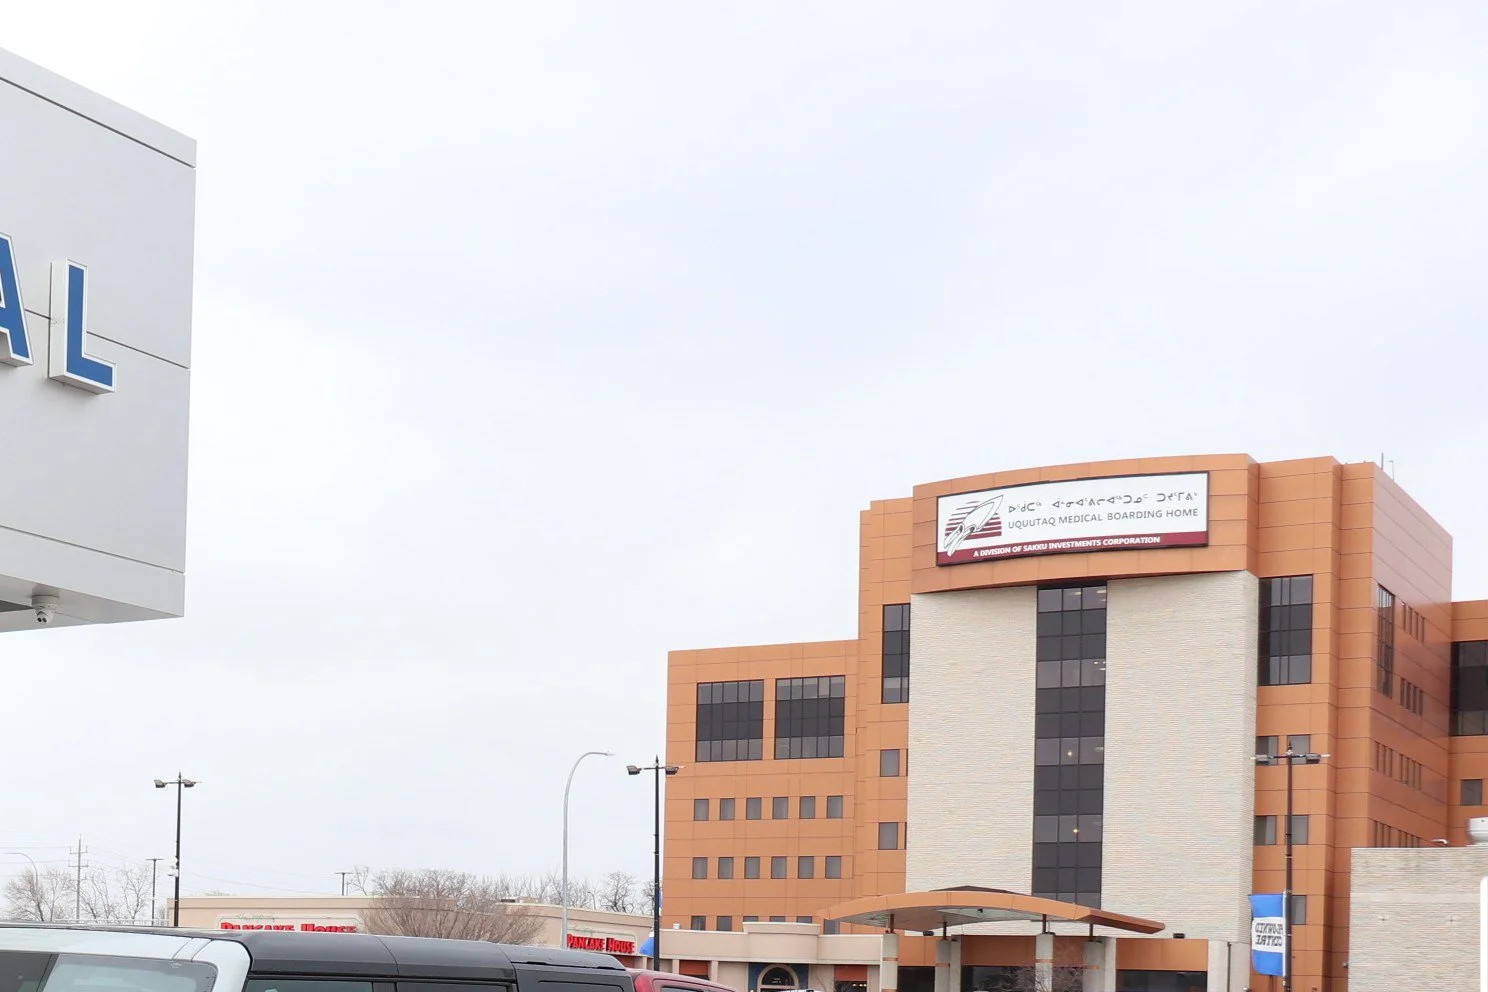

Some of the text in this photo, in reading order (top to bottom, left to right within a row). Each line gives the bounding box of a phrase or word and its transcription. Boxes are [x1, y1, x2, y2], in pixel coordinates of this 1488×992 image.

[1008, 508, 1199, 529] UQUUTAQ MEDICAL BOARDING HOME
[980, 546, 1011, 557] DIVISION
[1012, 545, 1022, 553] OF
[1023, 542, 1047, 552] SAKKU
[1049, 538, 1101, 550] INVESTMENTS
[1102, 536, 1161, 547] CORPORATION
[566, 933, 635, 954] PANCAKE HOUSE
